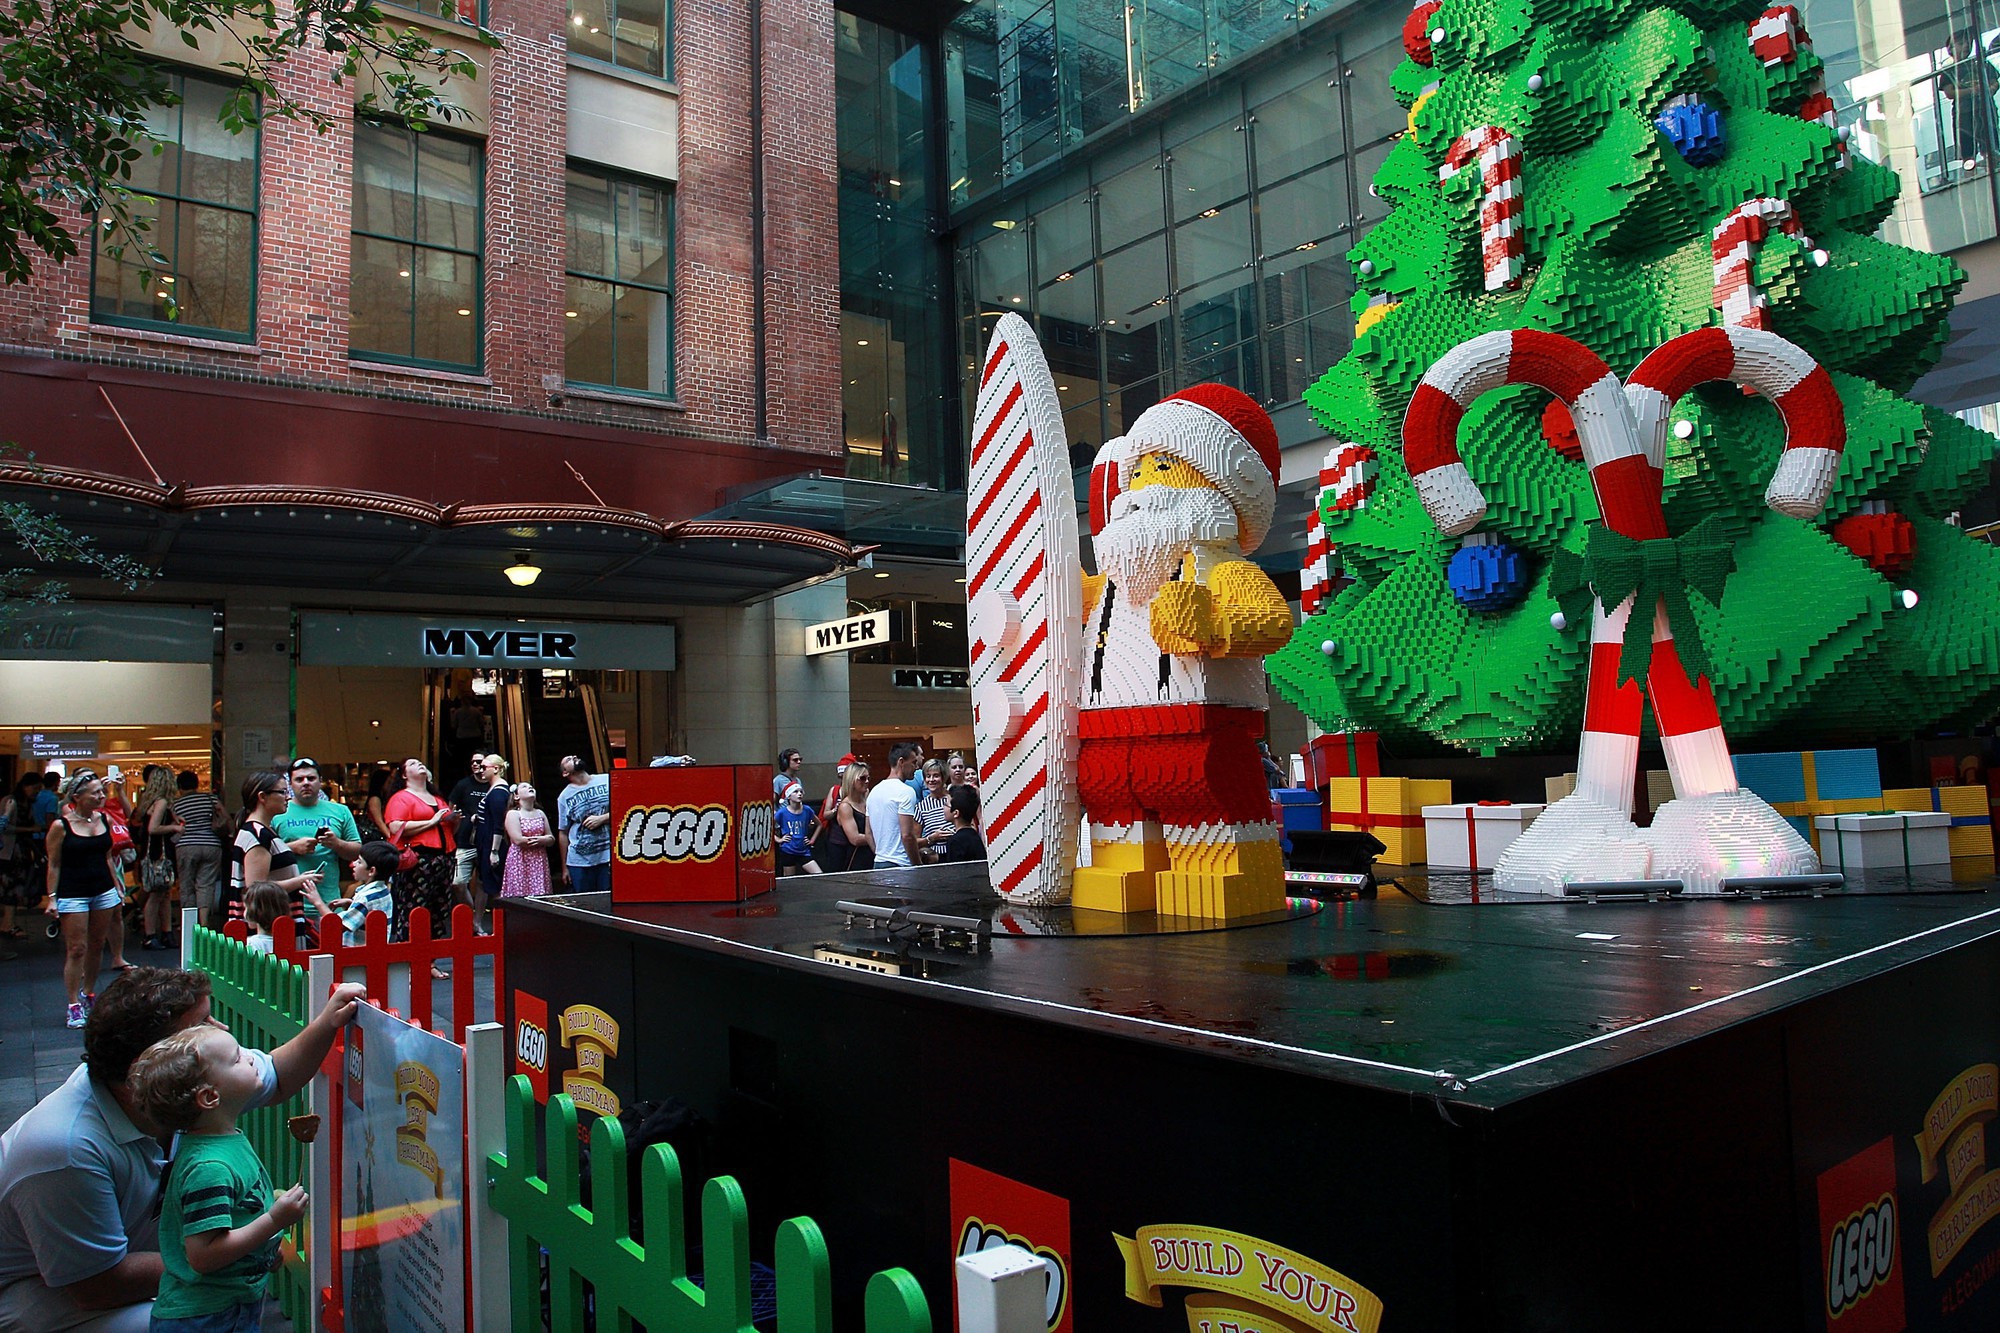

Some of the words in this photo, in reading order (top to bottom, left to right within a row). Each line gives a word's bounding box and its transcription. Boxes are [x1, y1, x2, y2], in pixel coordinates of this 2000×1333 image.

[424, 629, 577, 658] MYER
[816, 618, 876, 649] MYER
[895, 669, 970, 688] MYER
[287, 818, 319, 828] Hurley
[621, 809, 727, 858] LEGO
[740, 805, 772, 854] LEGO
[567, 1011, 590, 1030] BUILD
[592, 1013, 615, 1043] YOUR
[518, 1023, 546, 1068] LEGO
[350, 1046, 363, 1081] LEGO
[399, 1067, 416, 1085] BUILD
[418, 1069, 436, 1100] YOUR
[567, 1084, 615, 1115] CHRISTMAS
[1930, 1086, 1963, 1142] BUILD
[1965, 1074, 1994, 1104] YOUR
[399, 1141, 435, 1174] CHRISTMAS
[1935, 1177, 2000, 1260] CHRISTMAS
[1828, 1202, 1894, 1309] LEGO
[1150, 1237, 1245, 1276] BUILD
[1254, 1250, 1359, 1333] YOUR
